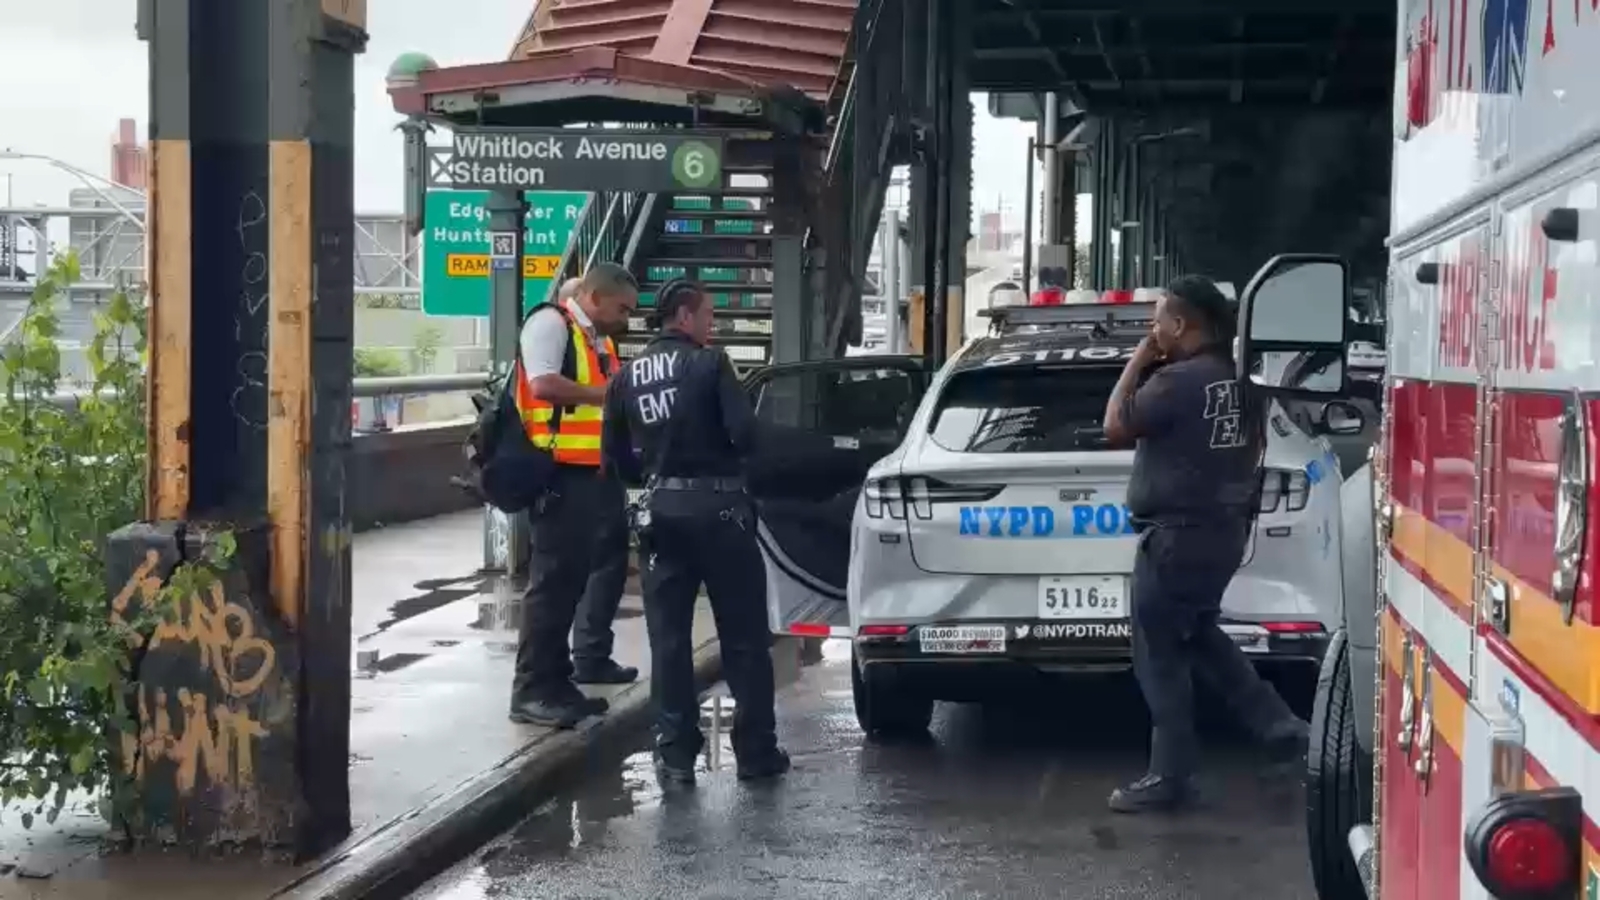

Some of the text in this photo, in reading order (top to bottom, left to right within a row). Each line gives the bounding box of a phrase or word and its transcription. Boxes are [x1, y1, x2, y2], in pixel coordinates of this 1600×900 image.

[454, 135, 668, 161] Whitlock Avenue
[453, 160, 545, 185] Station
[683, 149, 705, 179] 6
[452, 258, 489, 271] RAM
[632, 351, 679, 388] FDNY
[638, 387, 678, 424] EMT
[959, 505, 1055, 537] NYPD
[1046, 587, 1118, 609] 5116 22
